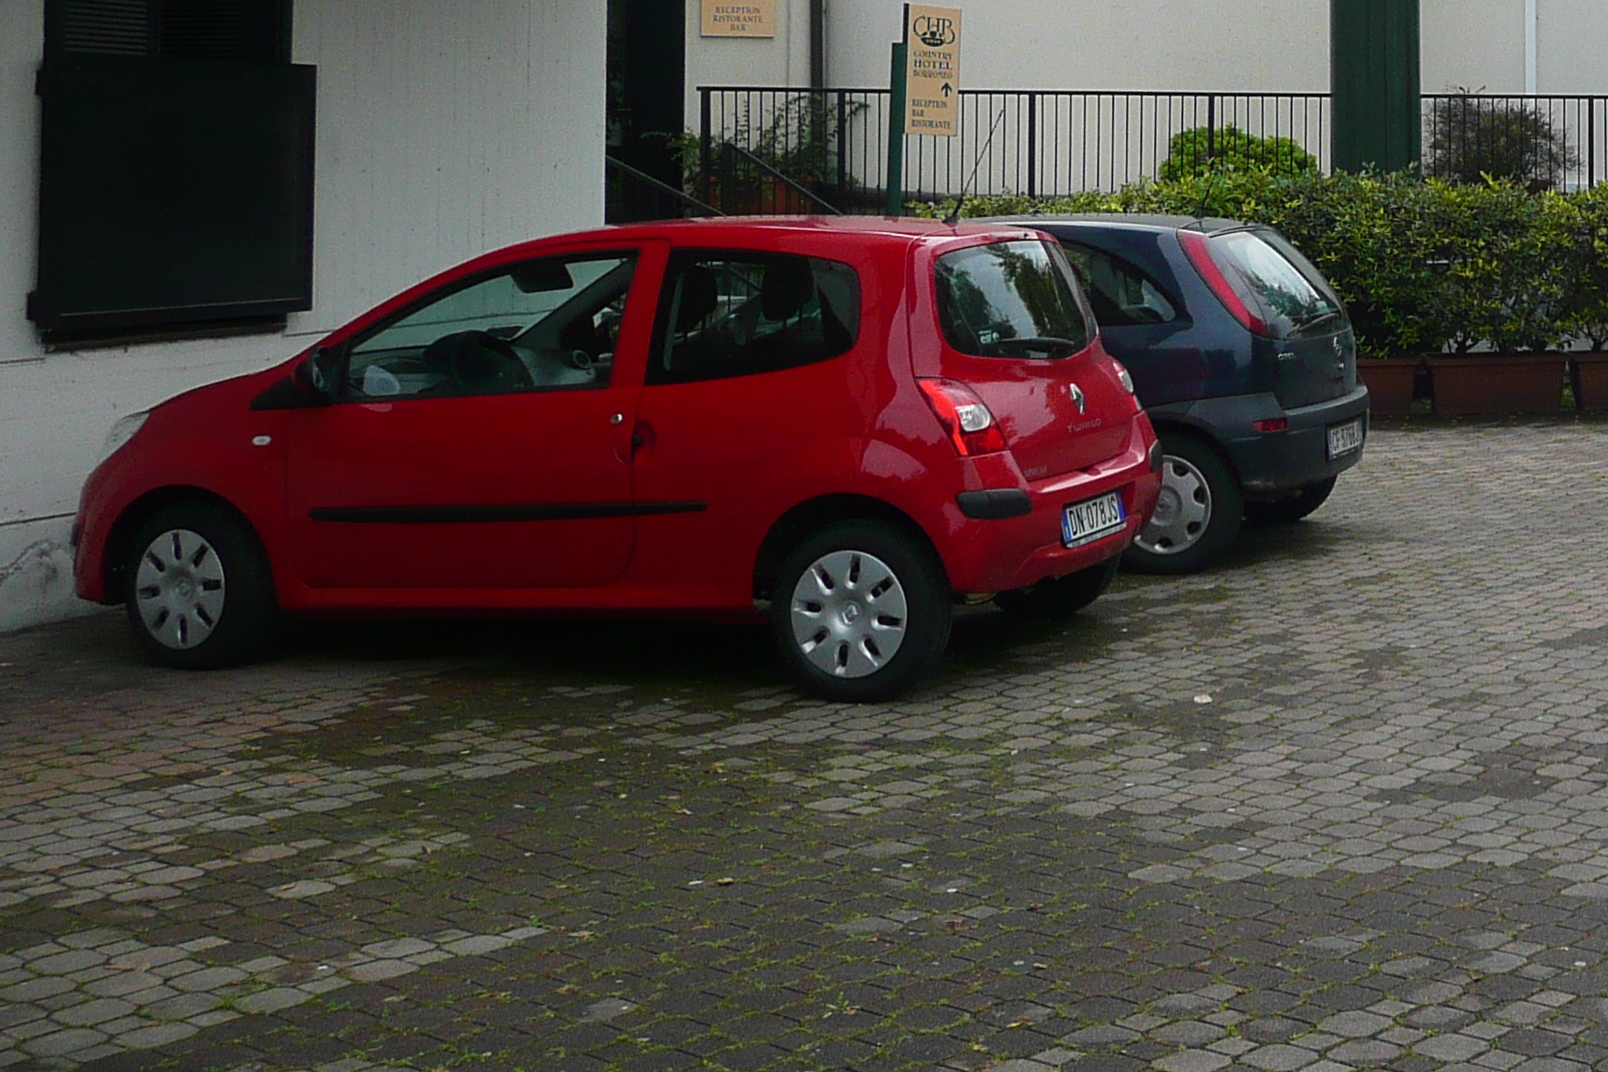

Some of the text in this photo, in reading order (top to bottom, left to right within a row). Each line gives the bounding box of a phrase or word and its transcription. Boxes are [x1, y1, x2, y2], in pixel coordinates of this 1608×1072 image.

[715, 6, 761, 14] RECEPTION
[713, 15, 763, 24] RISTORANTE
[730, 24, 746, 32] BAR
[913, 50, 953, 60] COUNTRY
[914, 59, 953, 70] HOTEL
[912, 99, 947, 109] RECEPTION
[912, 109, 925, 117] BAR
[911, 119, 952, 129] RISTORANTE
